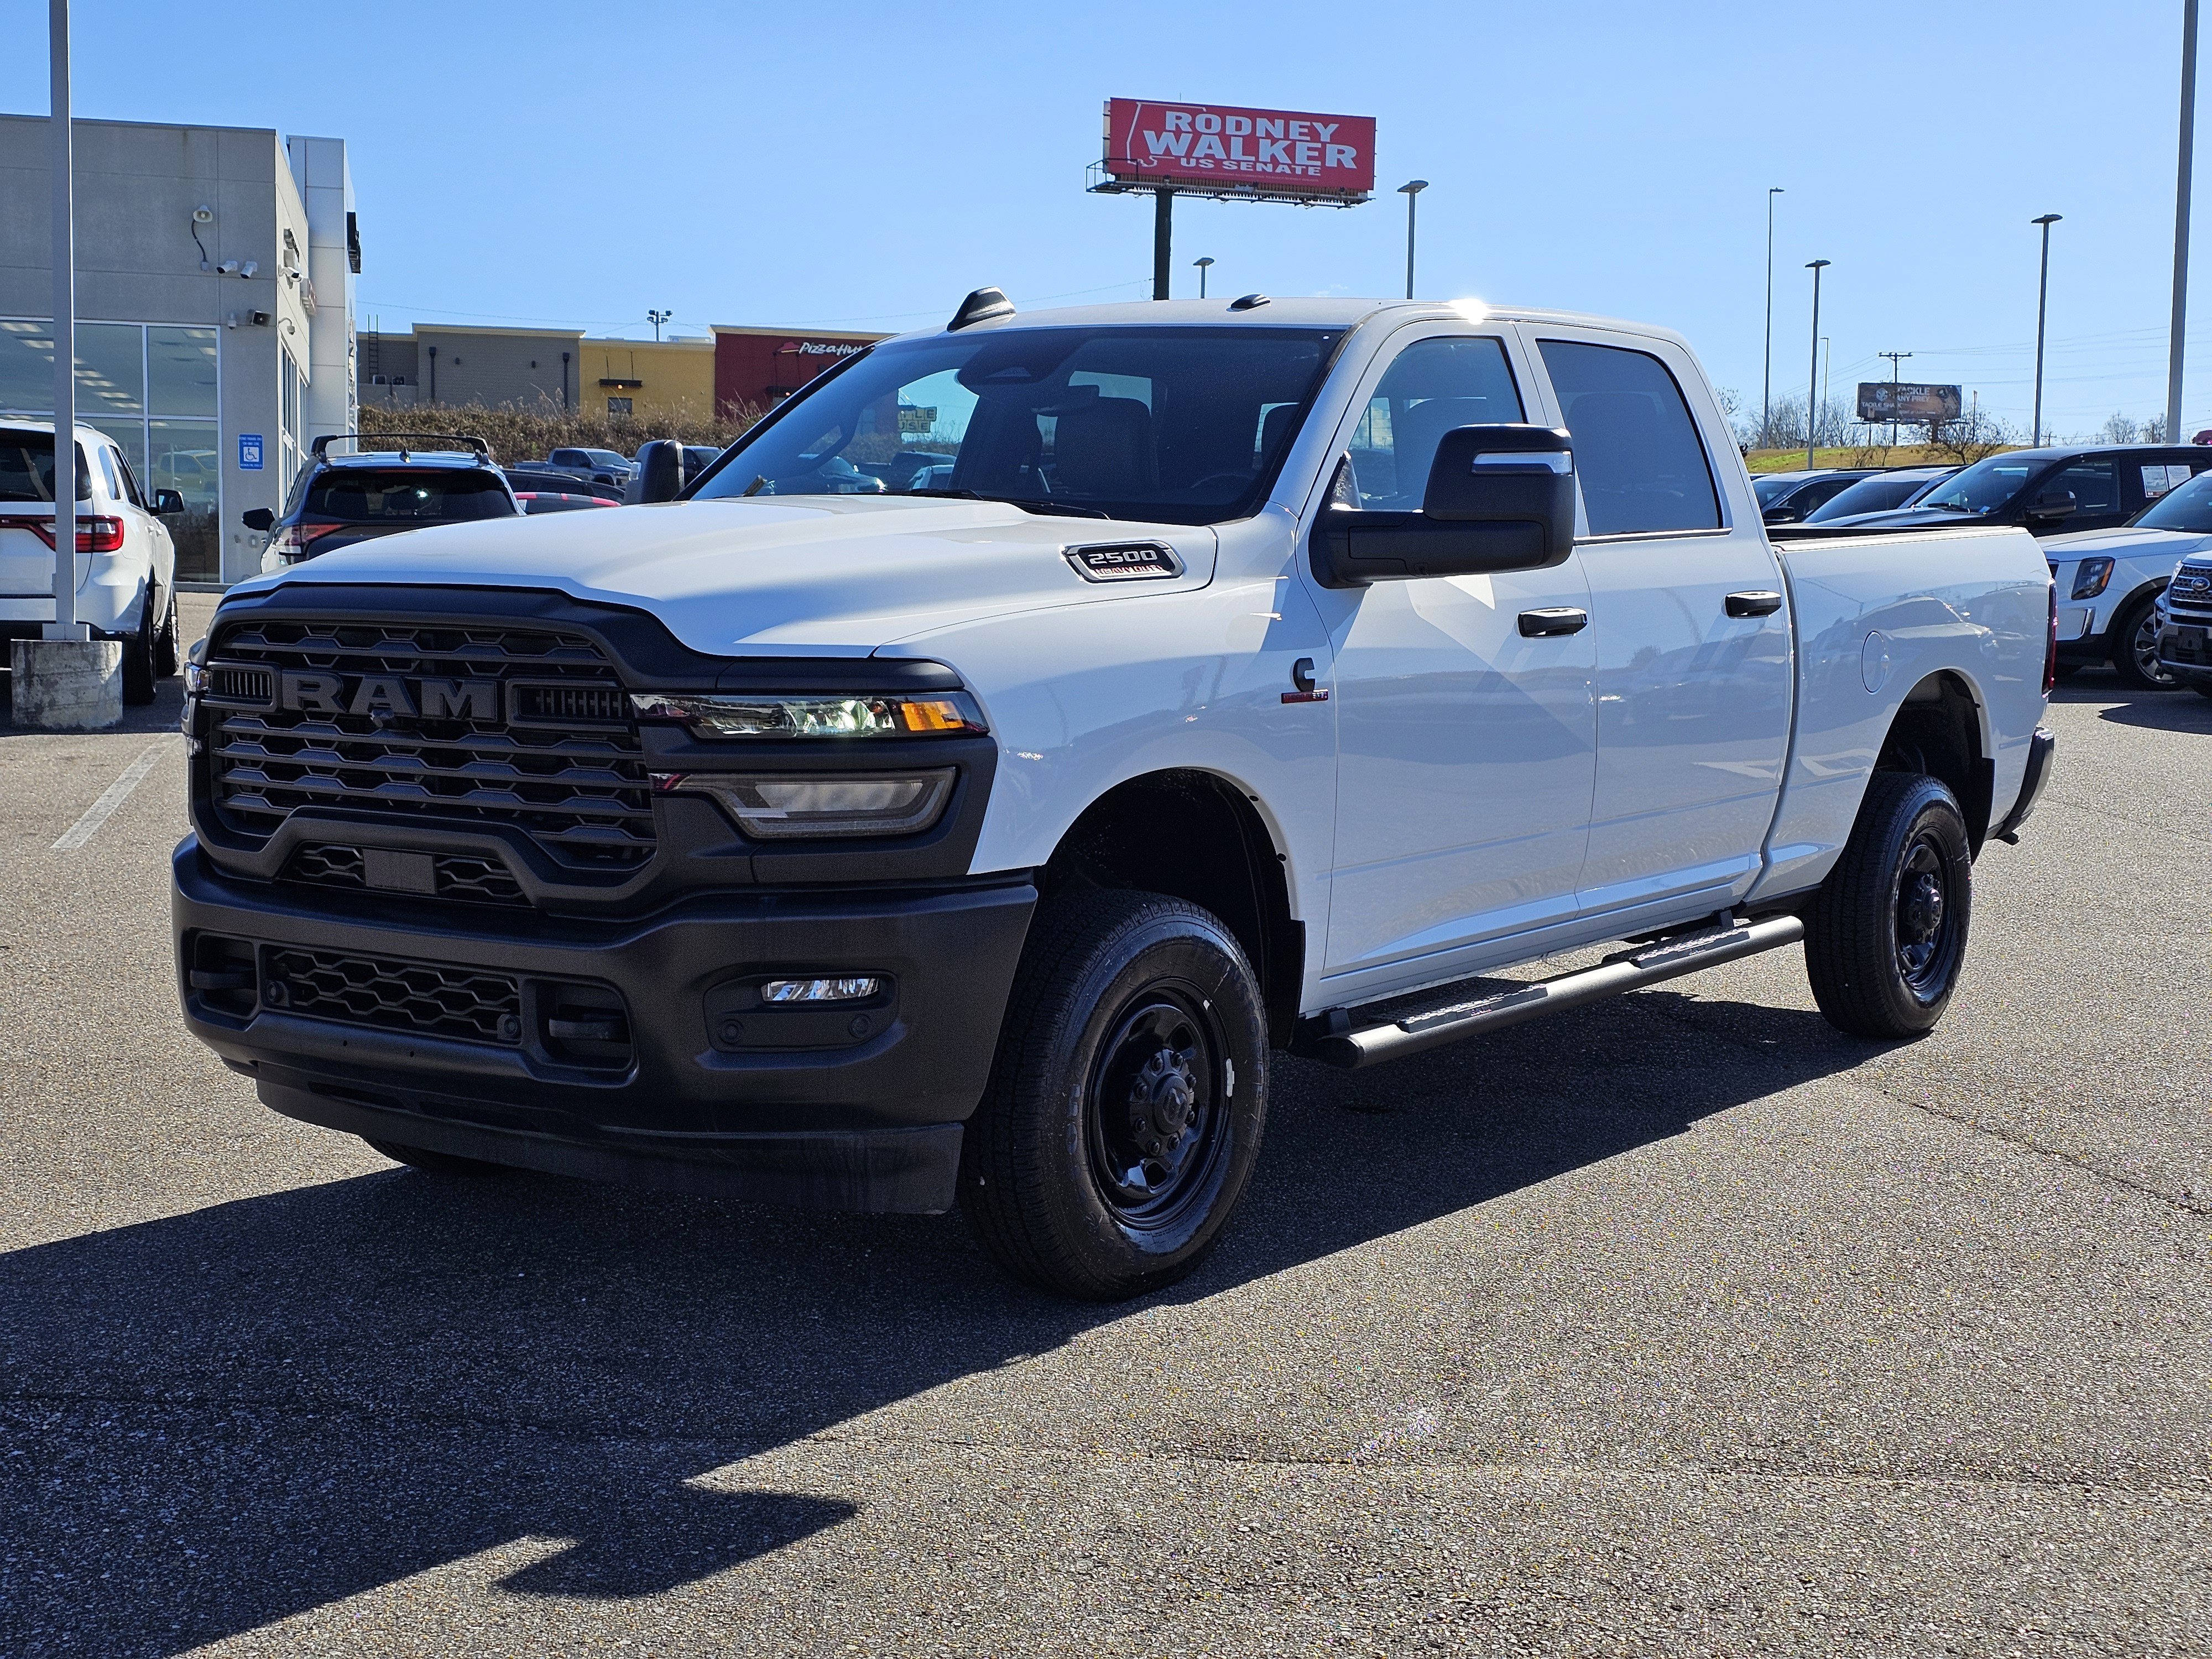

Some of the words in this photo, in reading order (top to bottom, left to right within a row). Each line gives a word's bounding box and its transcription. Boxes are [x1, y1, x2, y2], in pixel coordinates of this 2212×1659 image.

[1165, 111, 1340, 142] RODNEY
[1143, 130, 1357, 169] WALKER
[1180, 158, 1215, 169] US
[1223, 160, 1321, 176] SENATE
[1088, 550, 1158, 565] 2500
[1095, 566, 1133, 575] HEAVY
[282, 670, 499, 721] RAM
